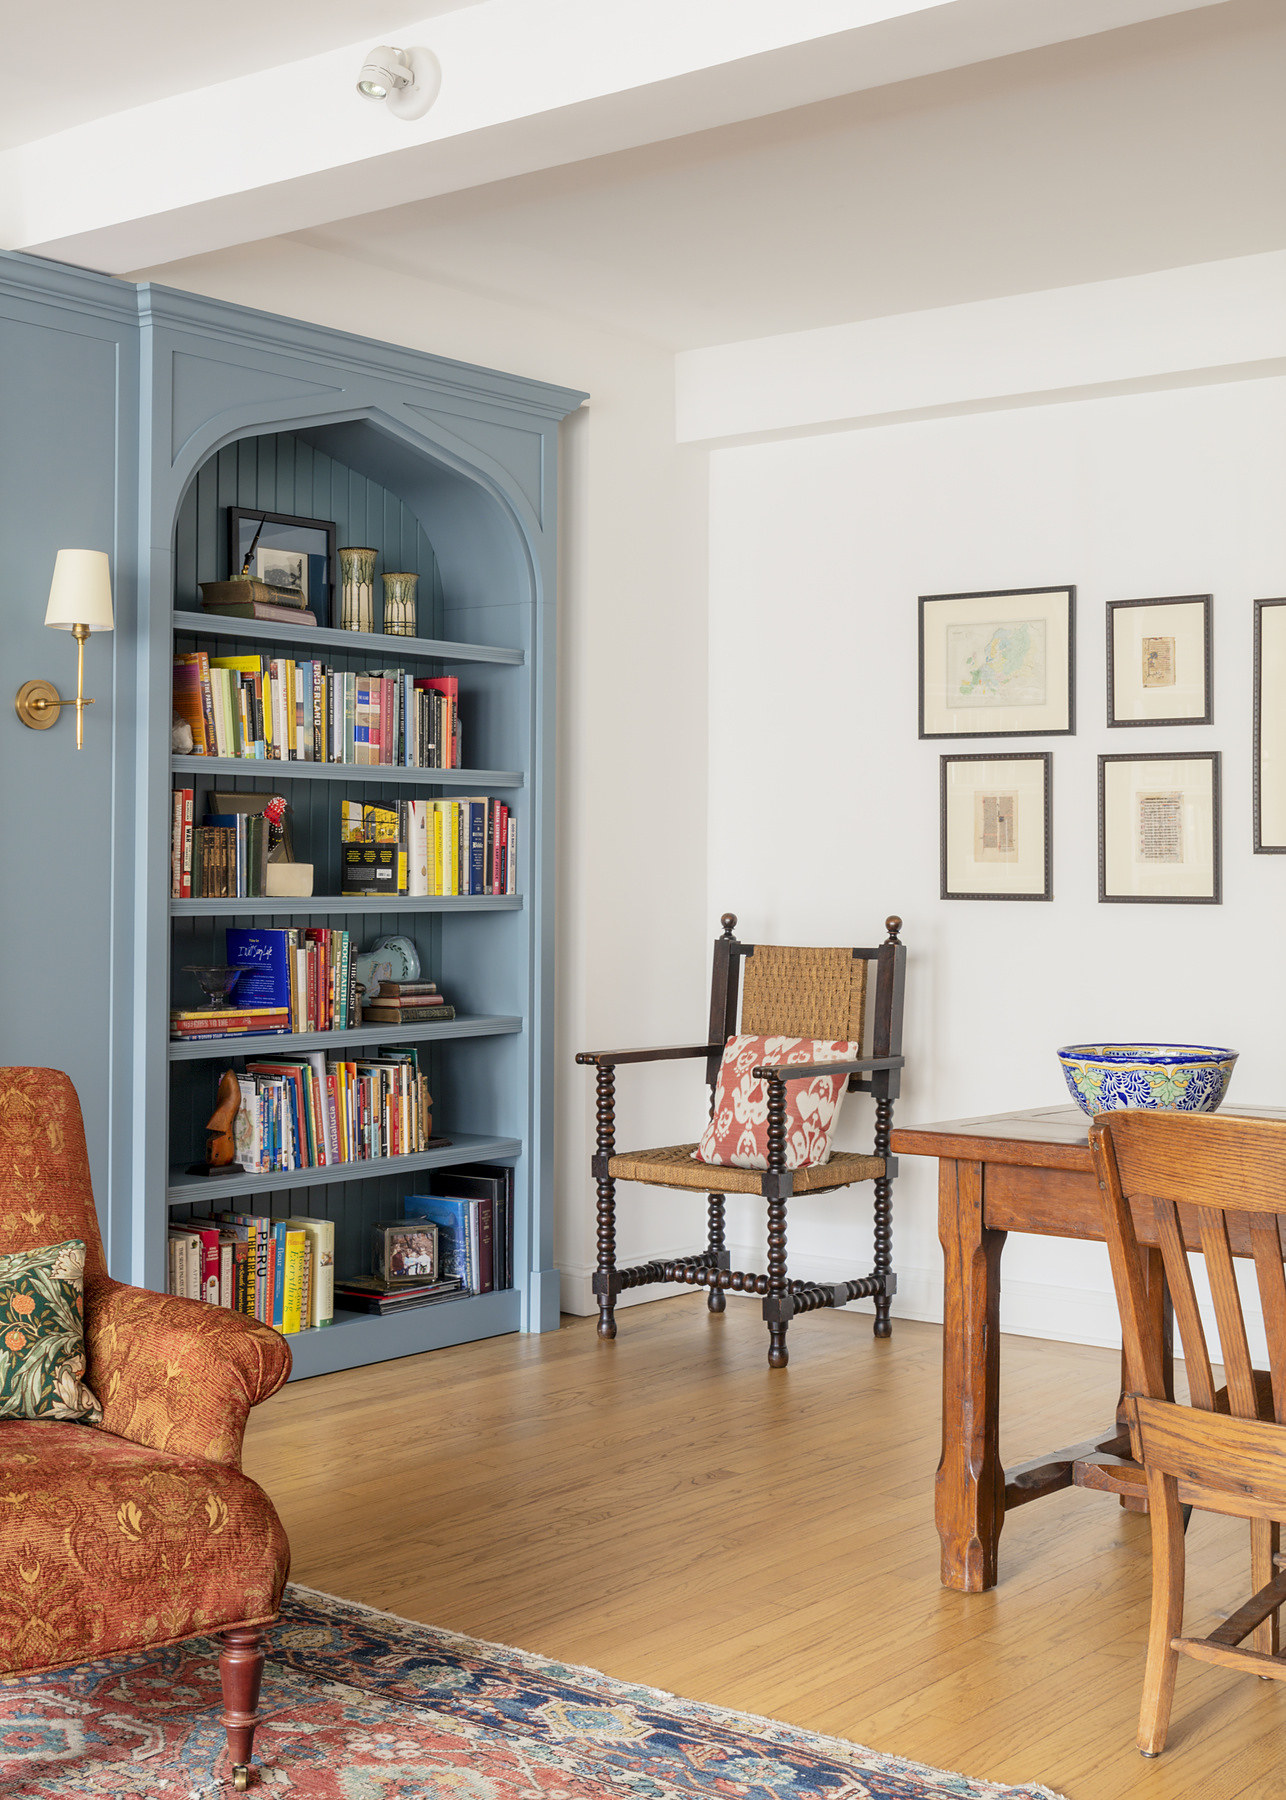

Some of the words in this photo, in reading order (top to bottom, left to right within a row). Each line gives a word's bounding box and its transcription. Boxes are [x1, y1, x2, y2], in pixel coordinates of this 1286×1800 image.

[313, 664, 321, 726] UNDERLAND
[330, 1106, 339, 1154] Andalucia
[247, 1235, 256, 1252] THE
[256, 1231, 268, 1278] PERU
[247, 1256, 256, 1275] FIRE
[277, 1247, 285, 1267] flour
[298, 1250, 306, 1271] How
[238, 1269, 246, 1286] South
[247, 1279, 256, 1289] OF
[284, 1250, 299, 1313] Everything
[297, 1275, 304, 1285] to
[238, 1286, 246, 1313] American
[246, 1293, 256, 1318] PERU
[295, 1287, 303, 1312] Cook
